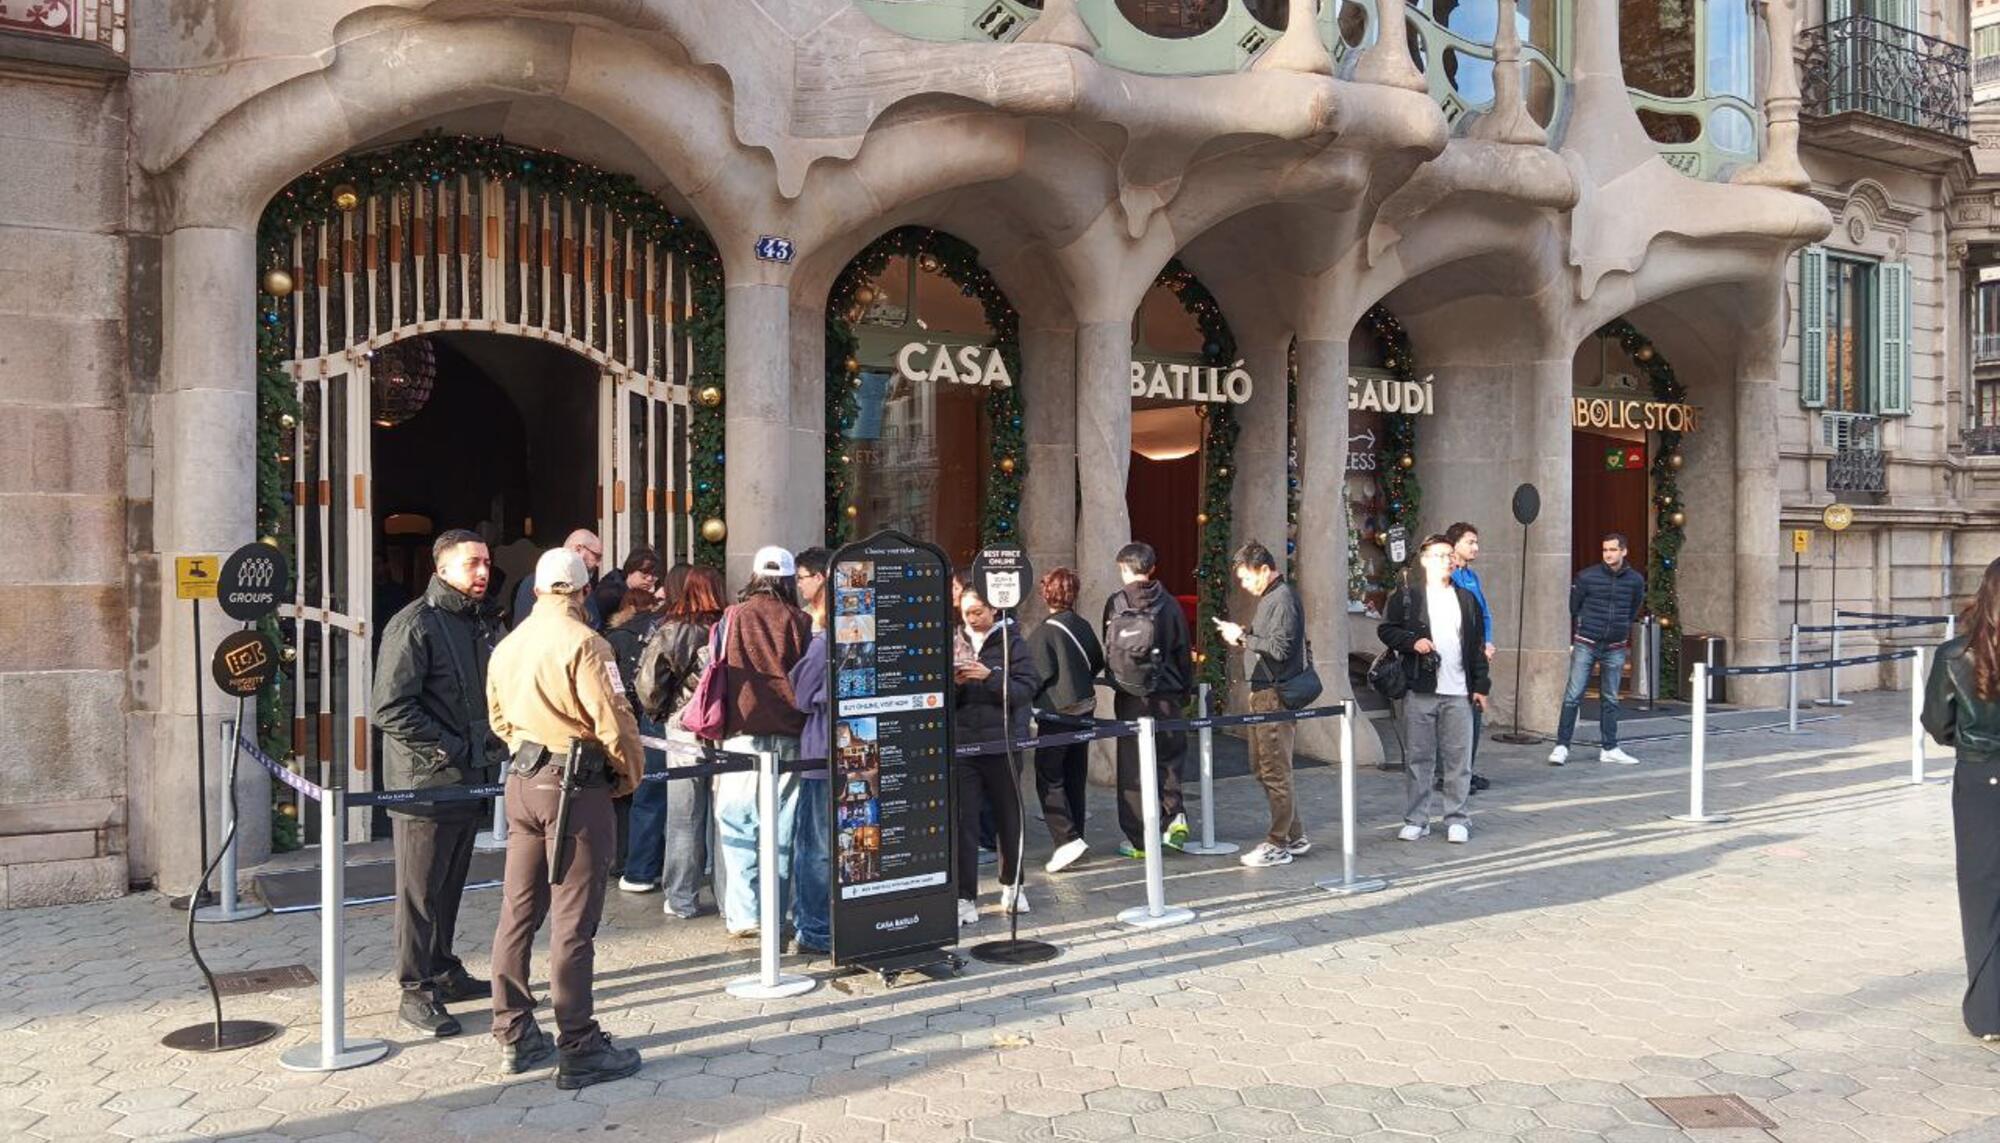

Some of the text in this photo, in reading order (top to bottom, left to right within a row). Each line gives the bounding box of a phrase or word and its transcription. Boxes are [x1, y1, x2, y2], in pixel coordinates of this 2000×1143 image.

[763, 239, 789, 259] 43
[899, 342, 1012, 388] CASA
[1131, 358, 1253, 405] BATLLÓ
[1571, 397, 1641, 430] BOLIC
[983, 550, 1021, 558] BEST PRICE
[988, 558, 1015, 566] ONLINE
[229, 592, 274, 604] GROUPS
[875, 919, 894, 931] CASA
[895, 913, 920, 927] BATLLÓ
